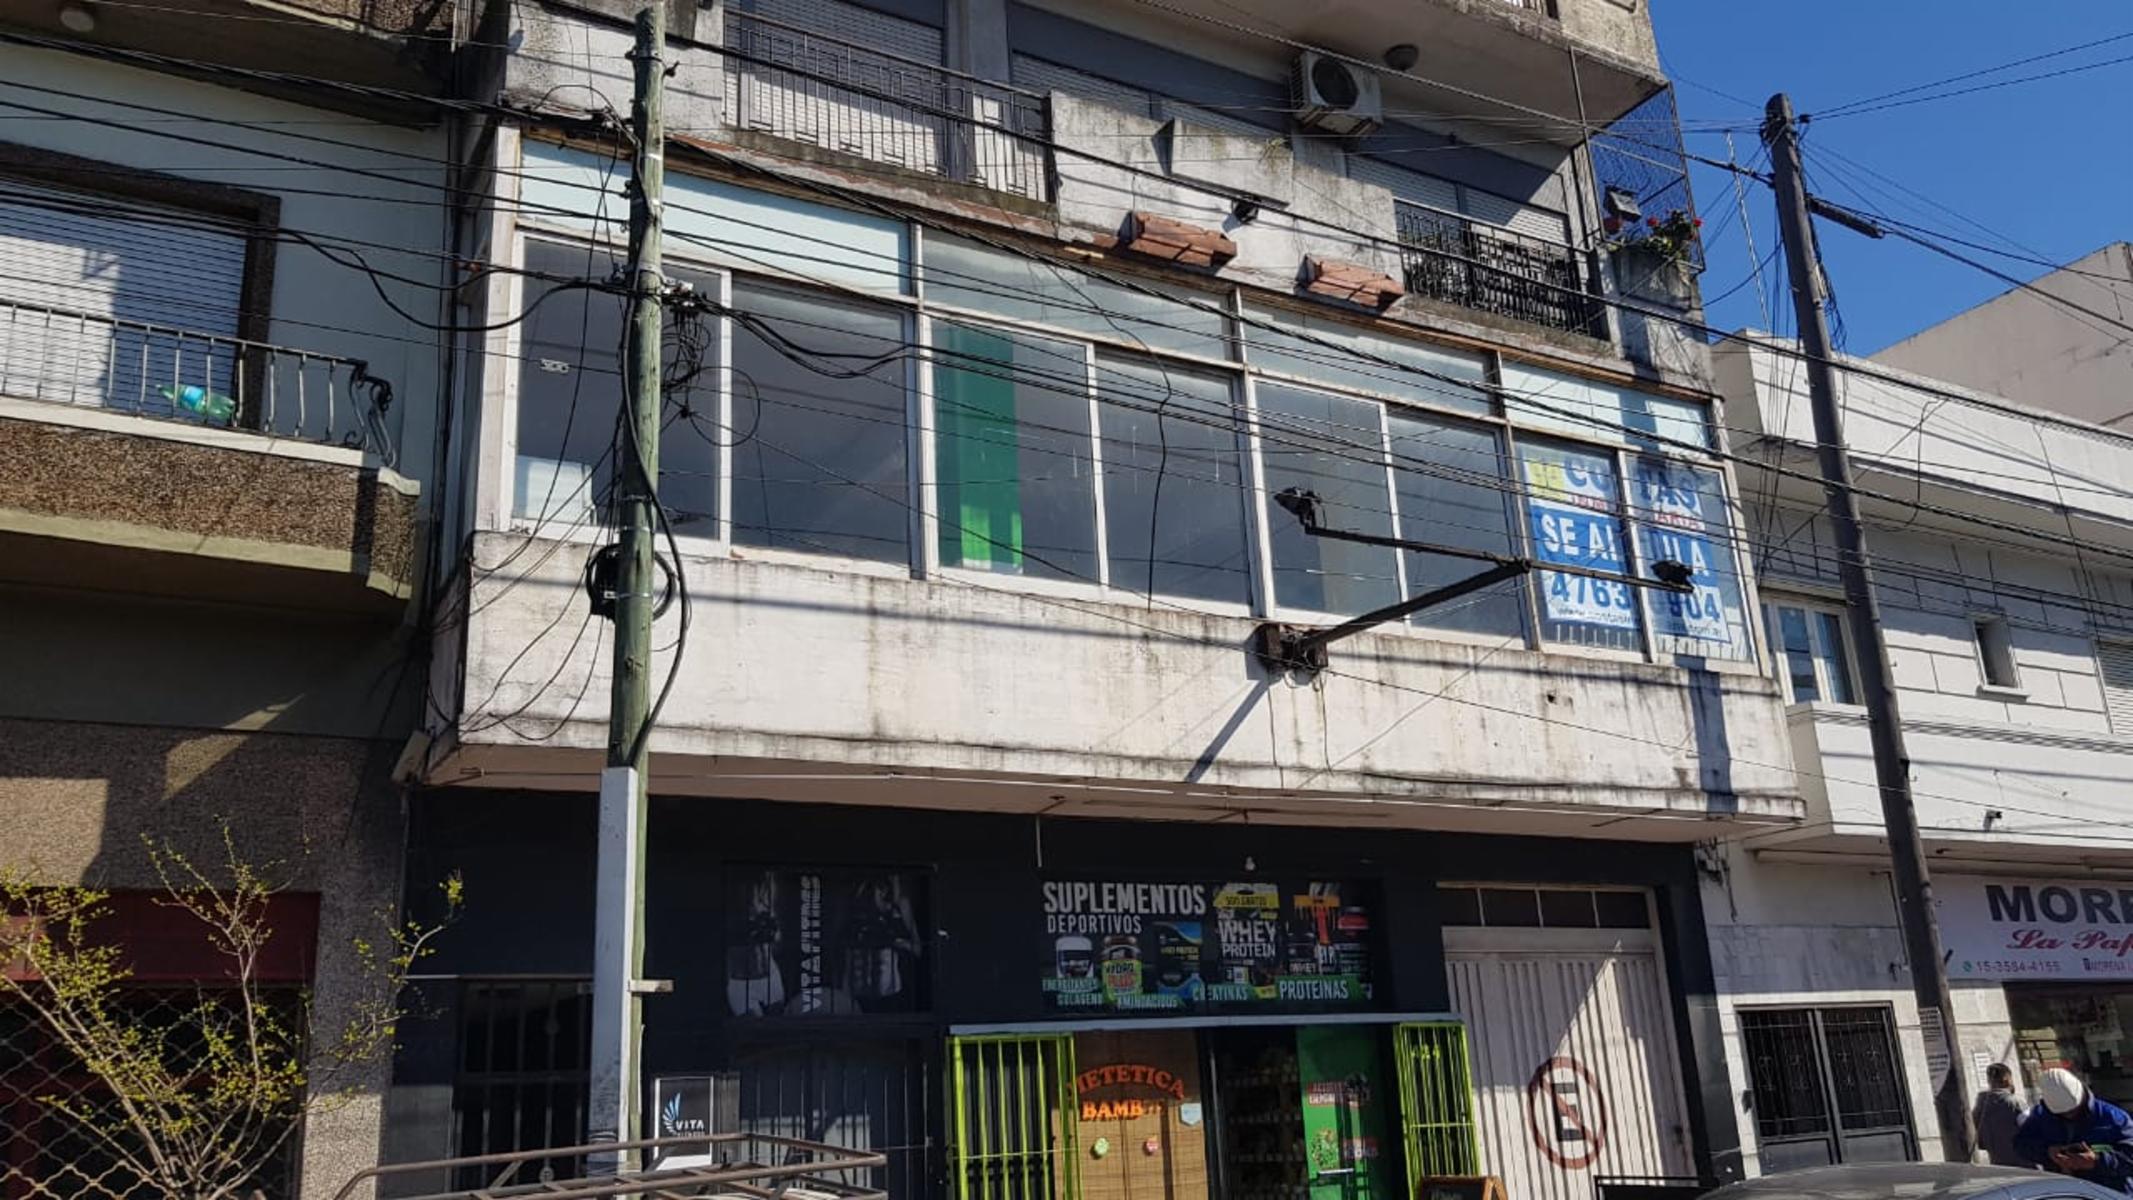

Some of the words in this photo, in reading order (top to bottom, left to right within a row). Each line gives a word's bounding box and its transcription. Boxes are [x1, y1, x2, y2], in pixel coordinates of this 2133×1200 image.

[1541, 514, 1579, 556] SE
[1042, 881, 1207, 914] SUPLEMENTOS
[1047, 915, 1142, 934] DEPORTIVOS
[1218, 920, 1276, 943] WHEY
[2006, 929, 2063, 949] La
[1222, 943, 1276, 958] PROTEIN
[1067, 1064, 1184, 1101] IETETICA
[675, 1119, 705, 1131] VITA
